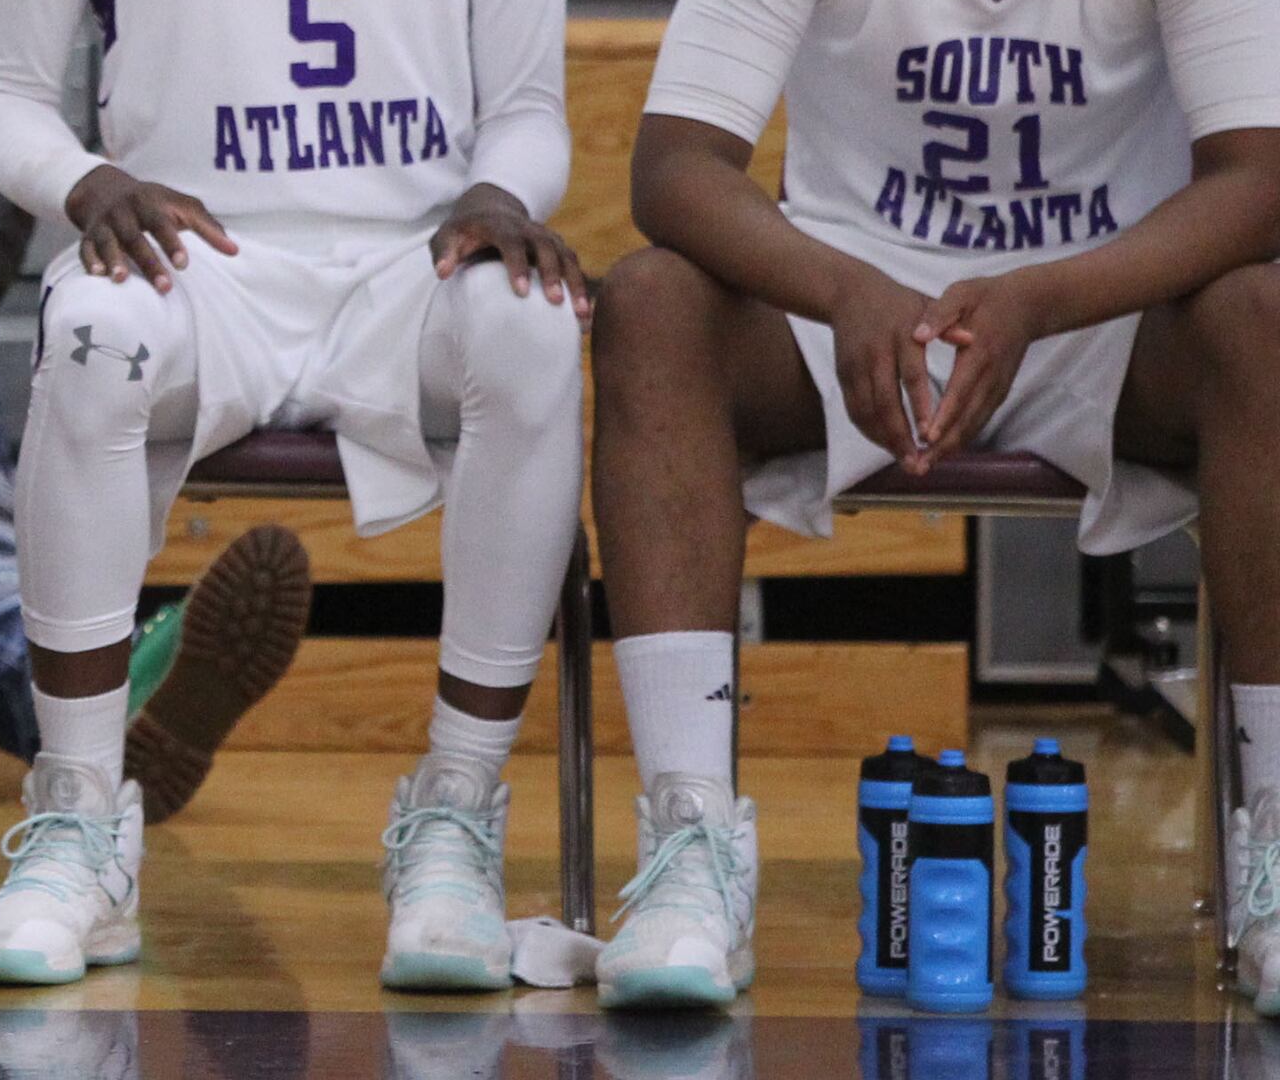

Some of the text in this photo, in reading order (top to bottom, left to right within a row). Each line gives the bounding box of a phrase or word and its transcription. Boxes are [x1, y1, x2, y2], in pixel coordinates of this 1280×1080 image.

[896, 36, 1087, 106] SOUTH
[214, 96, 448, 172] ATLANTA
[922, 110, 1050, 194] 21
[874, 166, 1119, 251] ATLANTA
[890, 821, 908, 959] POWERADE
[1043, 823, 1061, 962] POWERADE
